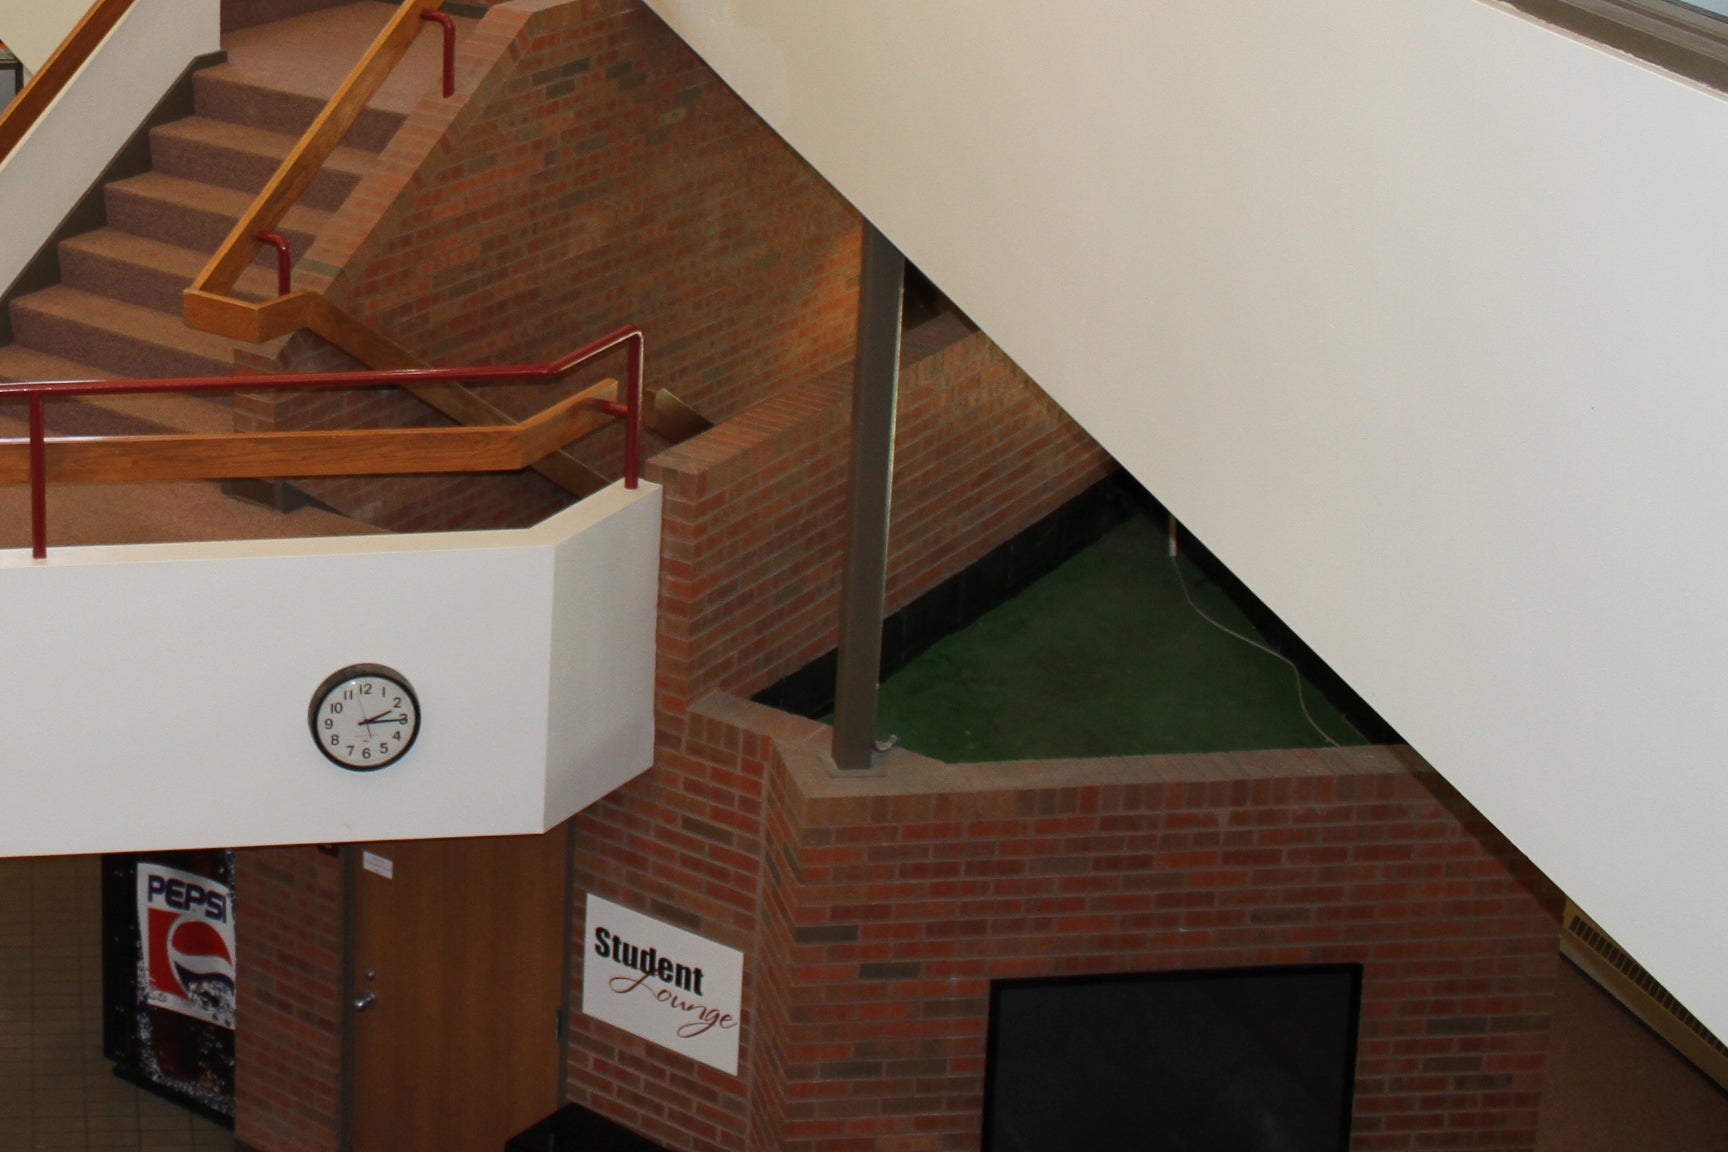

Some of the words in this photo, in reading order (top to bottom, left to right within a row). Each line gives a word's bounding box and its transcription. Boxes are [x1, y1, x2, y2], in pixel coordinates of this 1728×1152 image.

[359, 683, 372, 695] 12
[343, 690, 353, 701] 11
[330, 702, 343, 714] 10
[393, 697, 402, 708] 2
[324, 718, 333, 730] 9
[399, 713, 408, 725] 3
[331, 734, 340, 746] 8
[392, 730, 401, 741] 4
[346, 745, 355, 757] 7
[362, 748, 371, 759] 6
[380, 743, 389, 754] 5
[146, 874, 227, 924] PEPSI
[594, 926, 704, 997] Student
[608, 968, 738, 1039] Lounge
